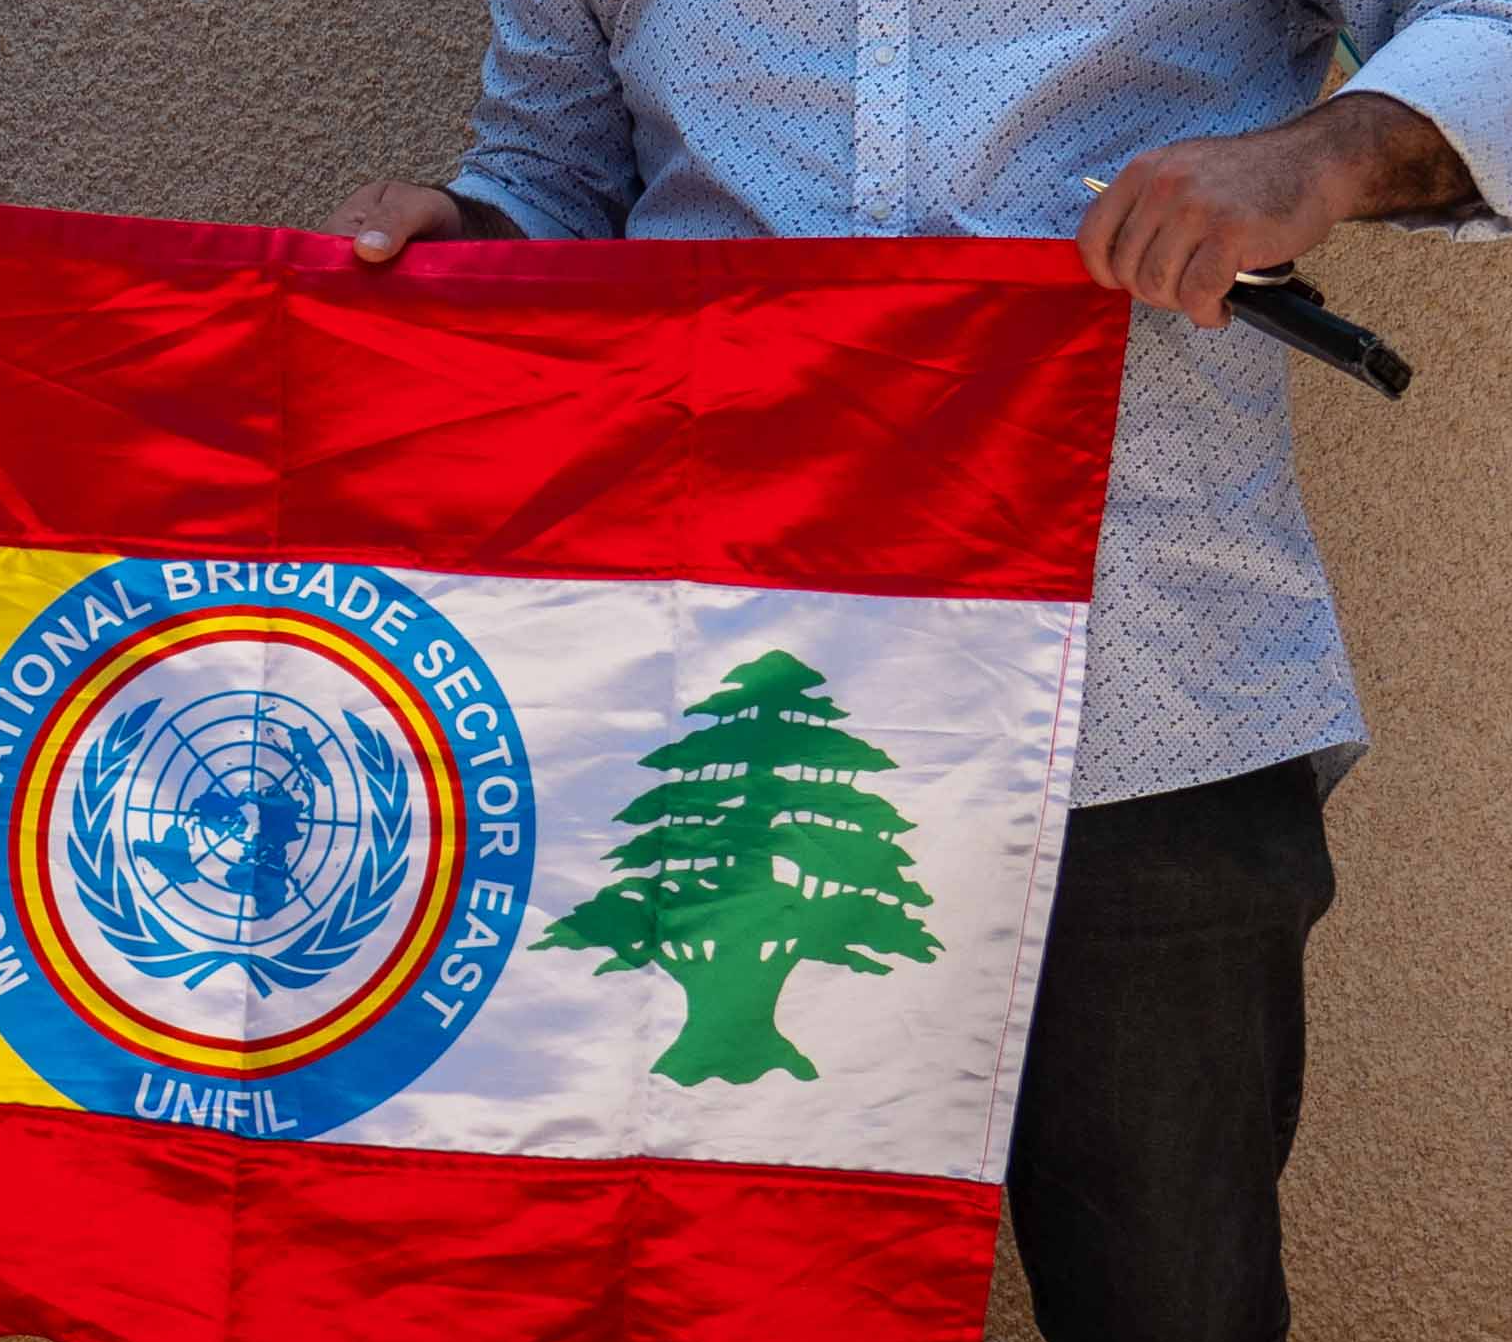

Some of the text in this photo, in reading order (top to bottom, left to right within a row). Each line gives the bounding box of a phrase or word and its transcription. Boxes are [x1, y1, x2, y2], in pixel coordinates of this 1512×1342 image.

[161, 560, 417, 647] BRIGADE
[413, 639, 520, 858] SECTOR
[421, 878, 514, 1029] EAST
[134, 1073, 298, 1134] UNIFIL
